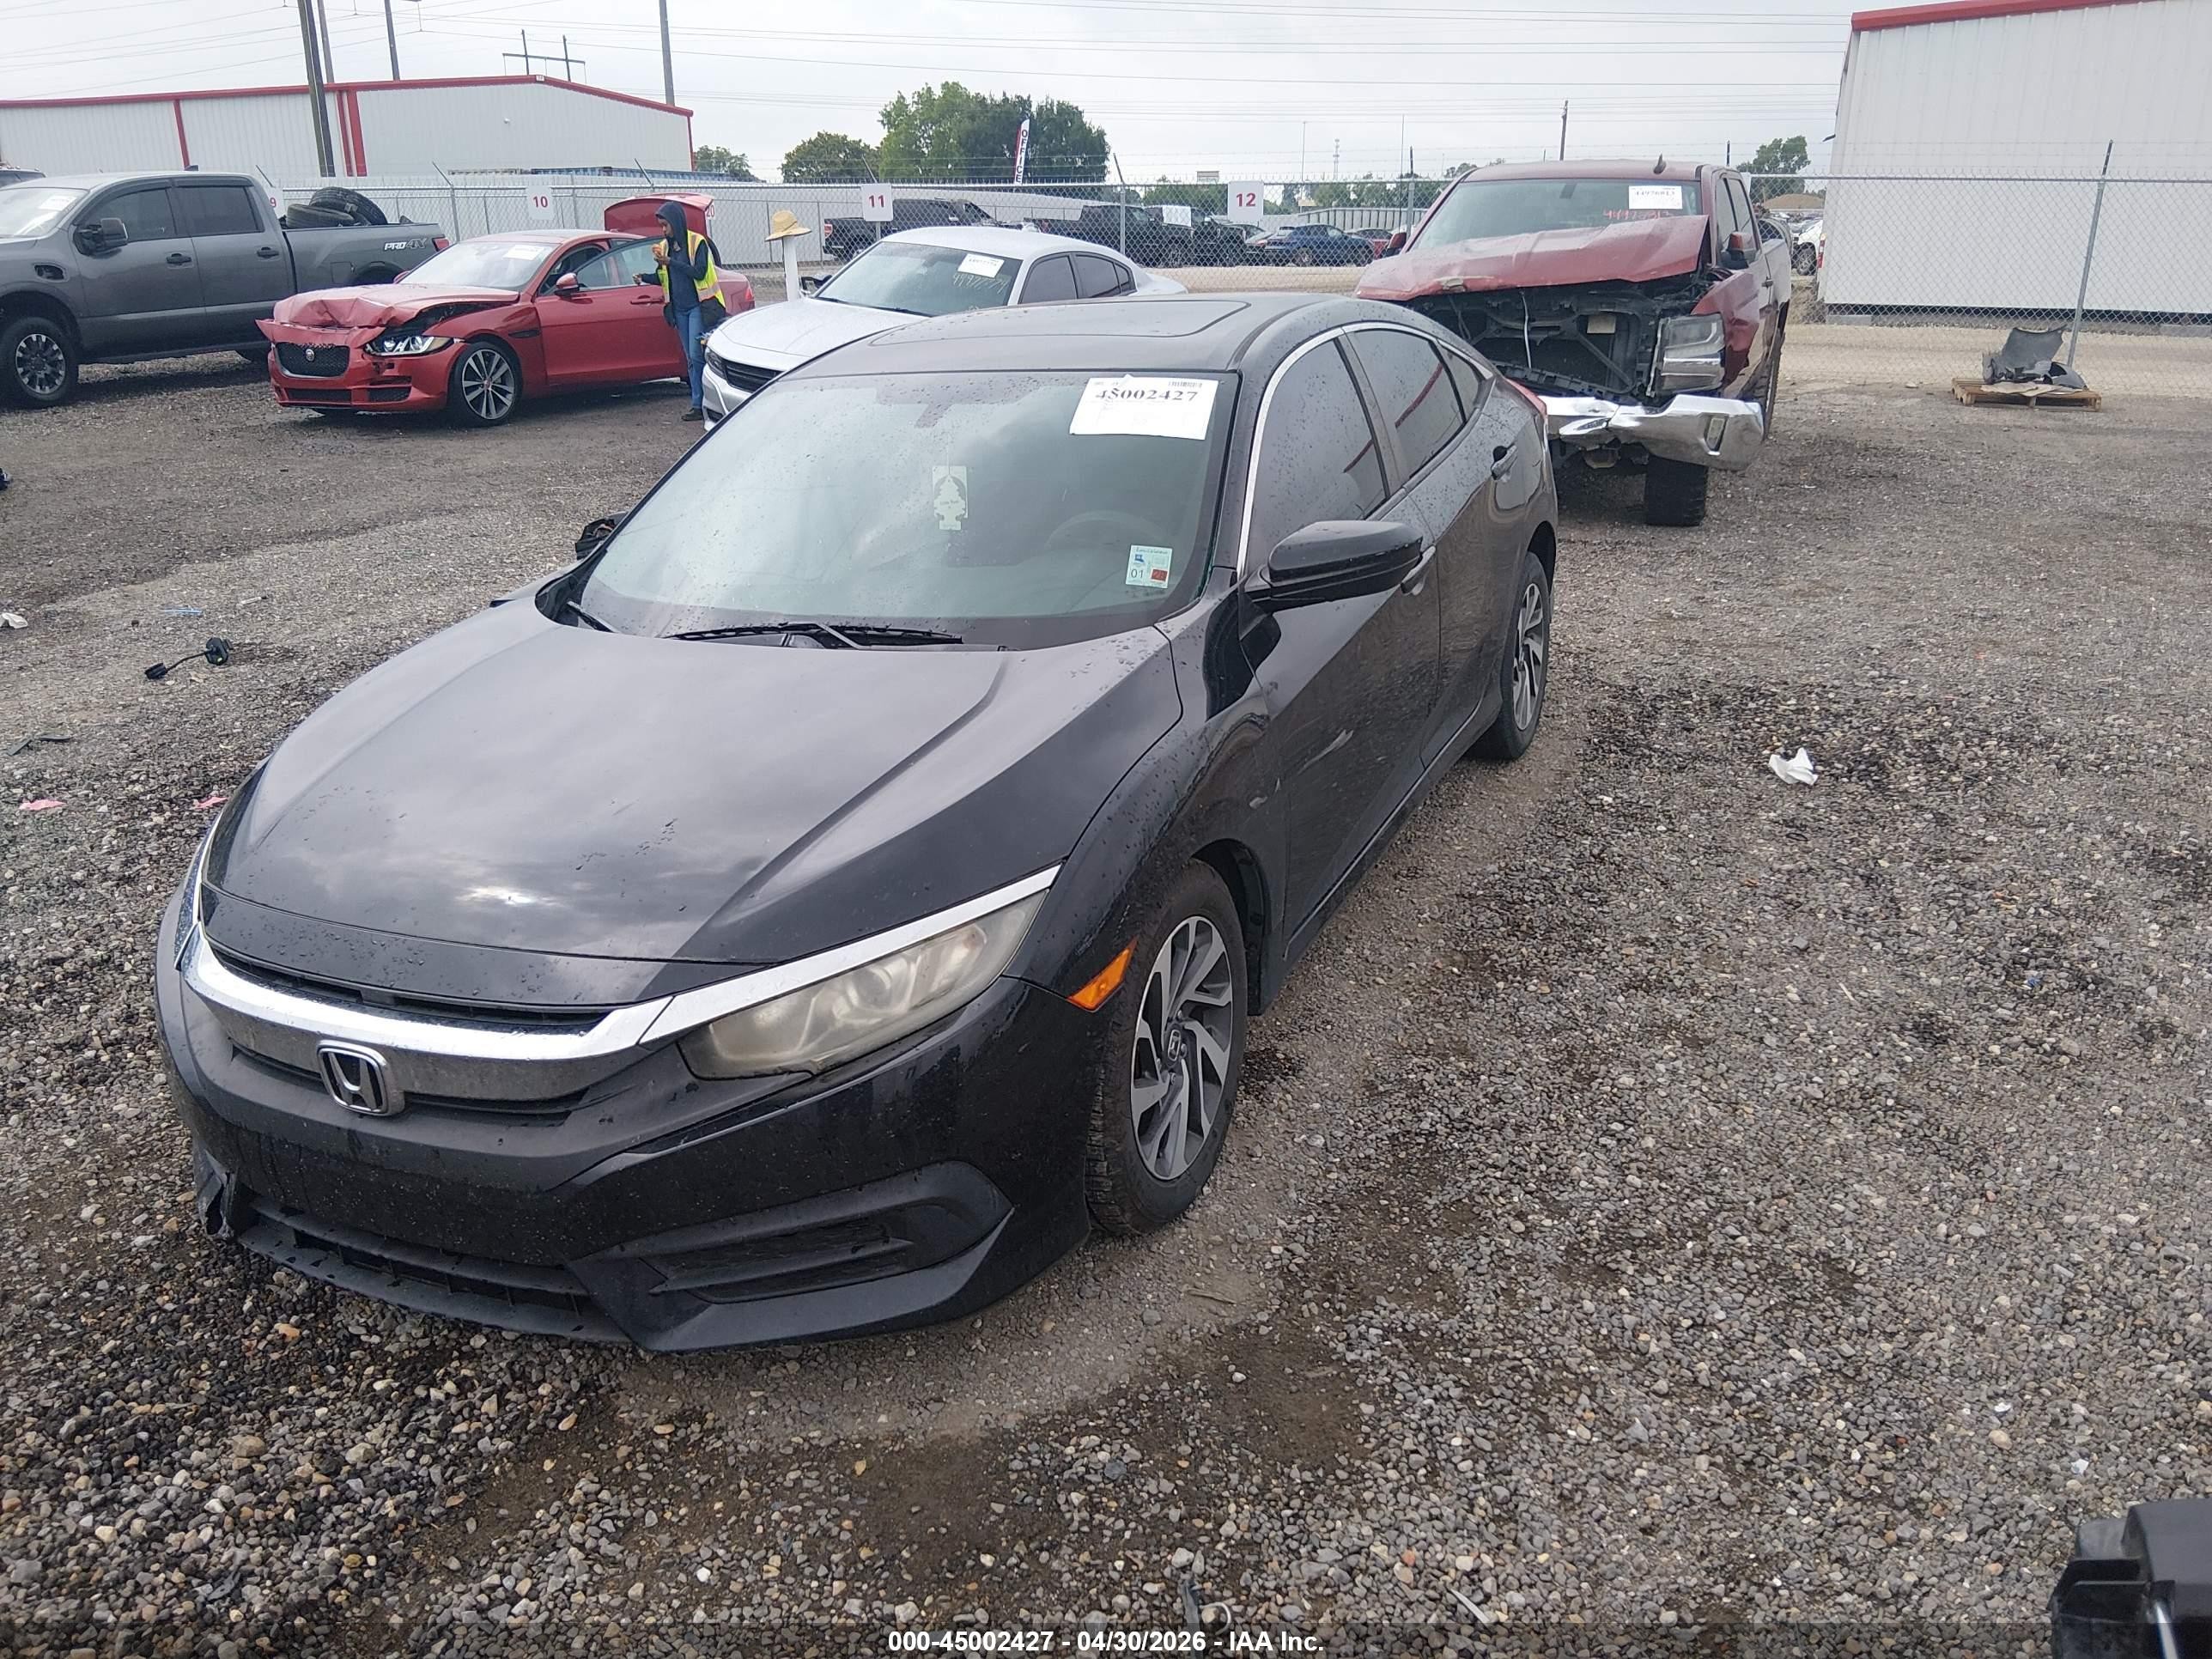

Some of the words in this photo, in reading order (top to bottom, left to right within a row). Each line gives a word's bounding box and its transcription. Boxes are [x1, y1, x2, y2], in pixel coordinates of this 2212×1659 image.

[1016, 129, 1028, 183] OFFICE
[270, 198, 276, 208] 9
[533, 196, 549, 208] 10
[869, 194, 884, 208] 11
[1237, 192, 1256, 207] 12
[1095, 387, 1198, 402] 45002427
[1131, 568, 1144, 579] 01
